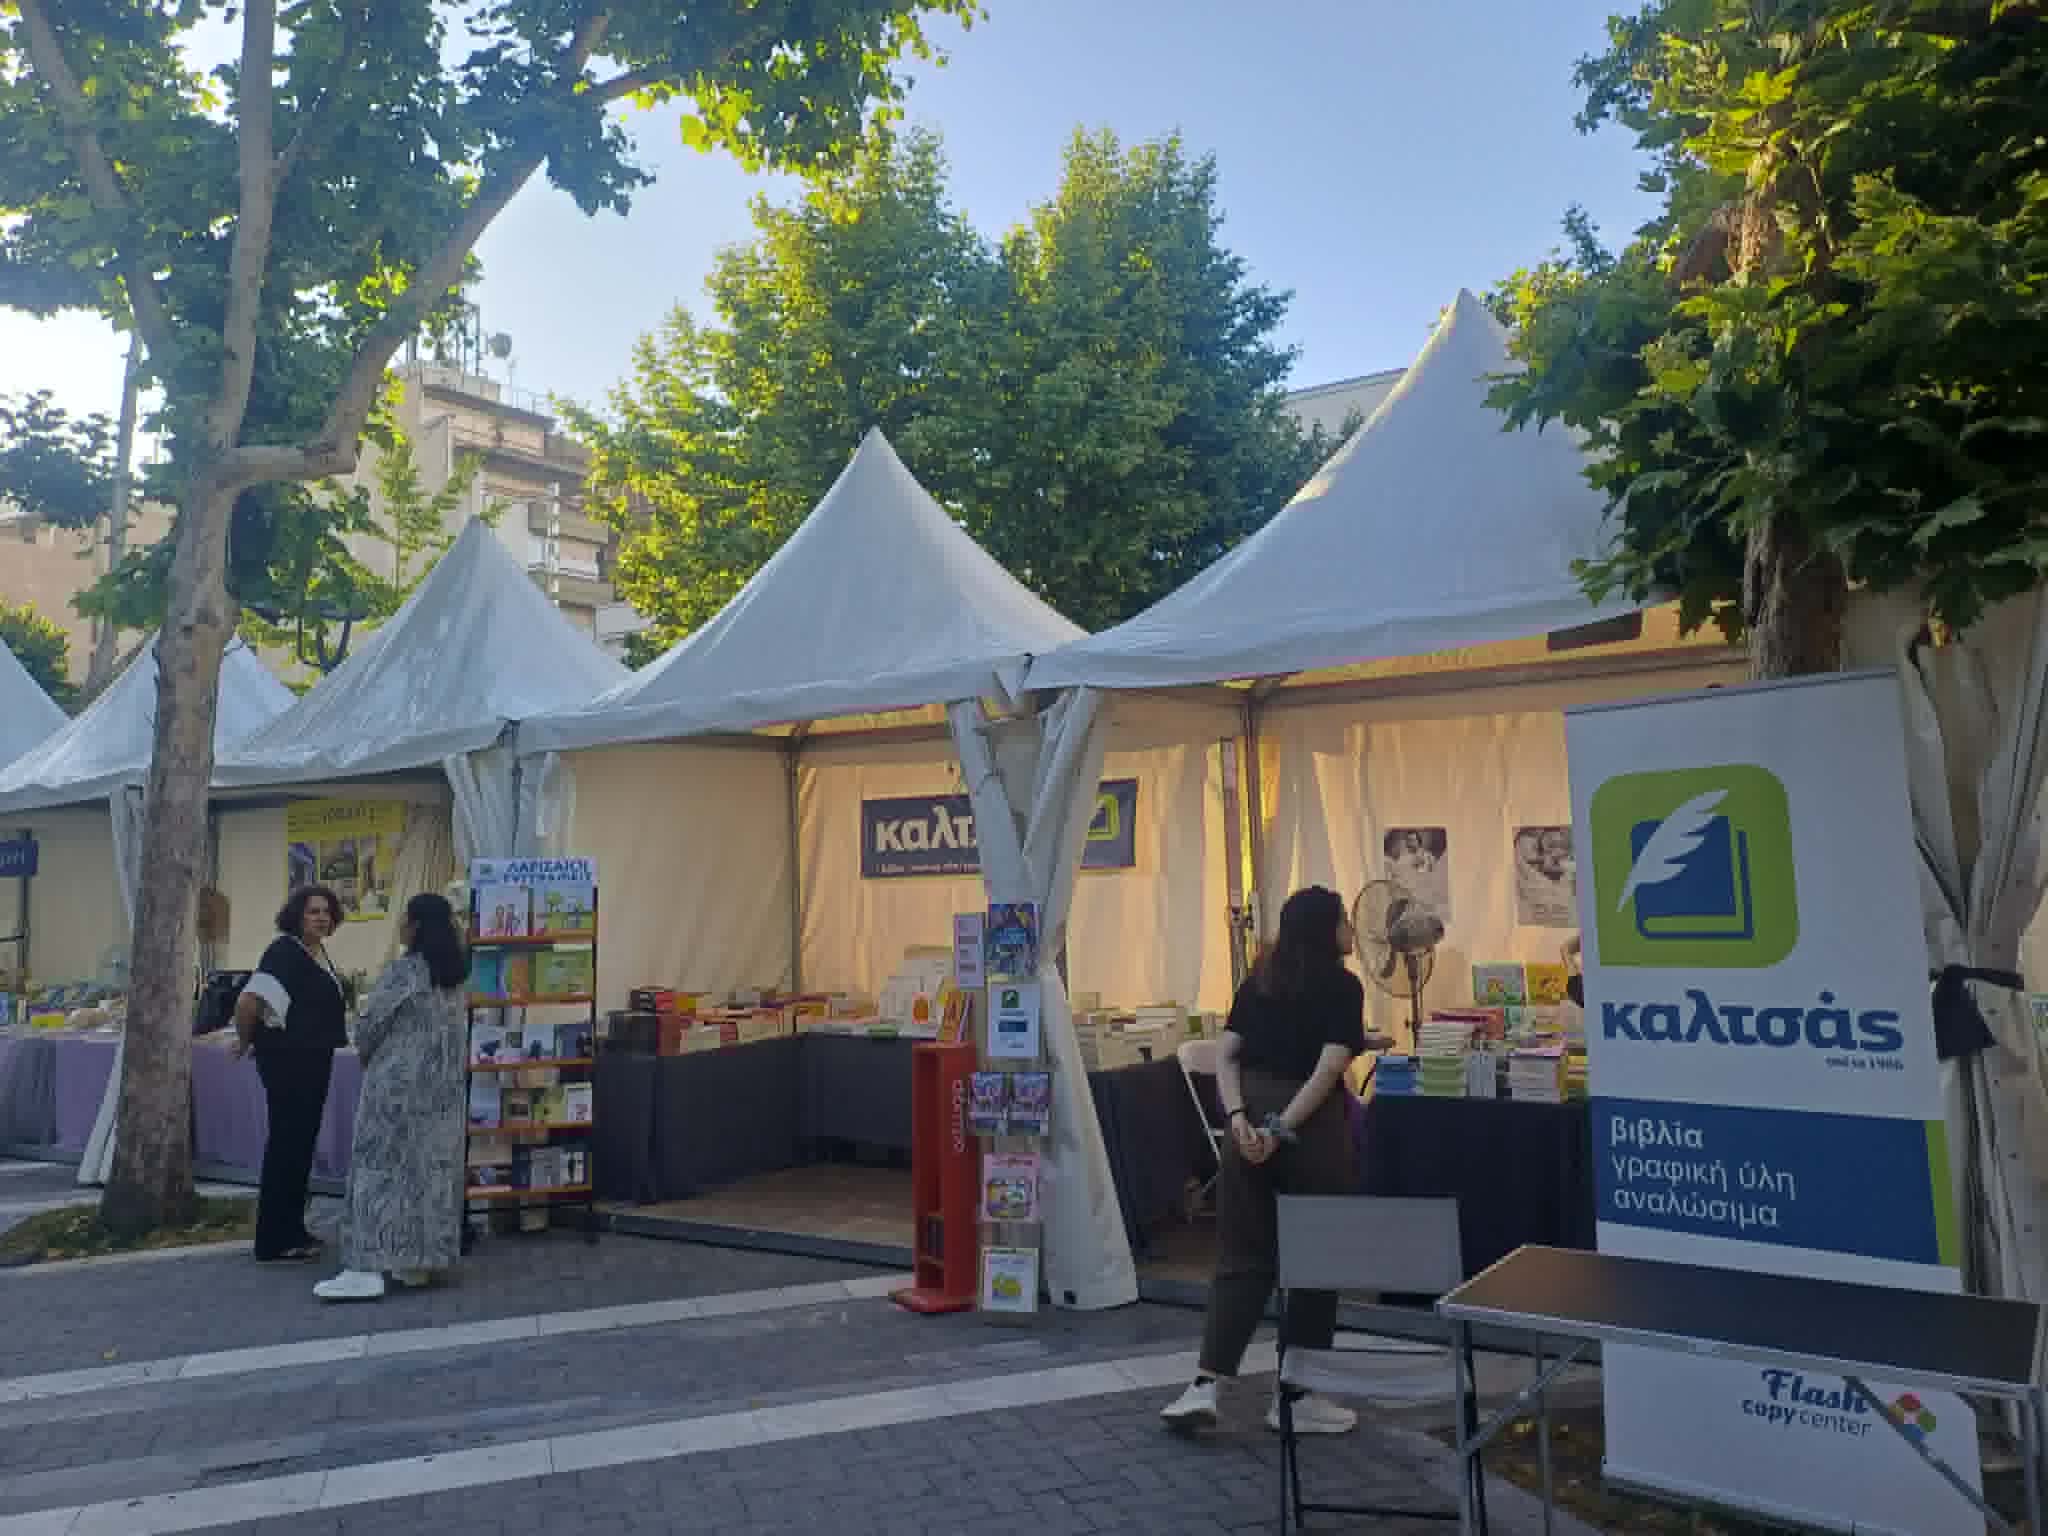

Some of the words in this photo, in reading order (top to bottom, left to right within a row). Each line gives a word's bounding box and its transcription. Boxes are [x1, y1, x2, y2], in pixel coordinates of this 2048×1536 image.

[876, 805, 977, 852] καλτ
[1602, 989, 1904, 1052] καλτσάς
[1611, 1115, 1704, 1149] βιβλία
[1611, 1154, 1728, 1192] γραφική
[1739, 1161, 1797, 1200] ύλη
[1615, 1188, 1778, 1231] αναλώσιμα
[1760, 1369, 1869, 1414] Flash
[1742, 1399, 1796, 1425] copy
[1799, 1409, 1872, 1437] center
